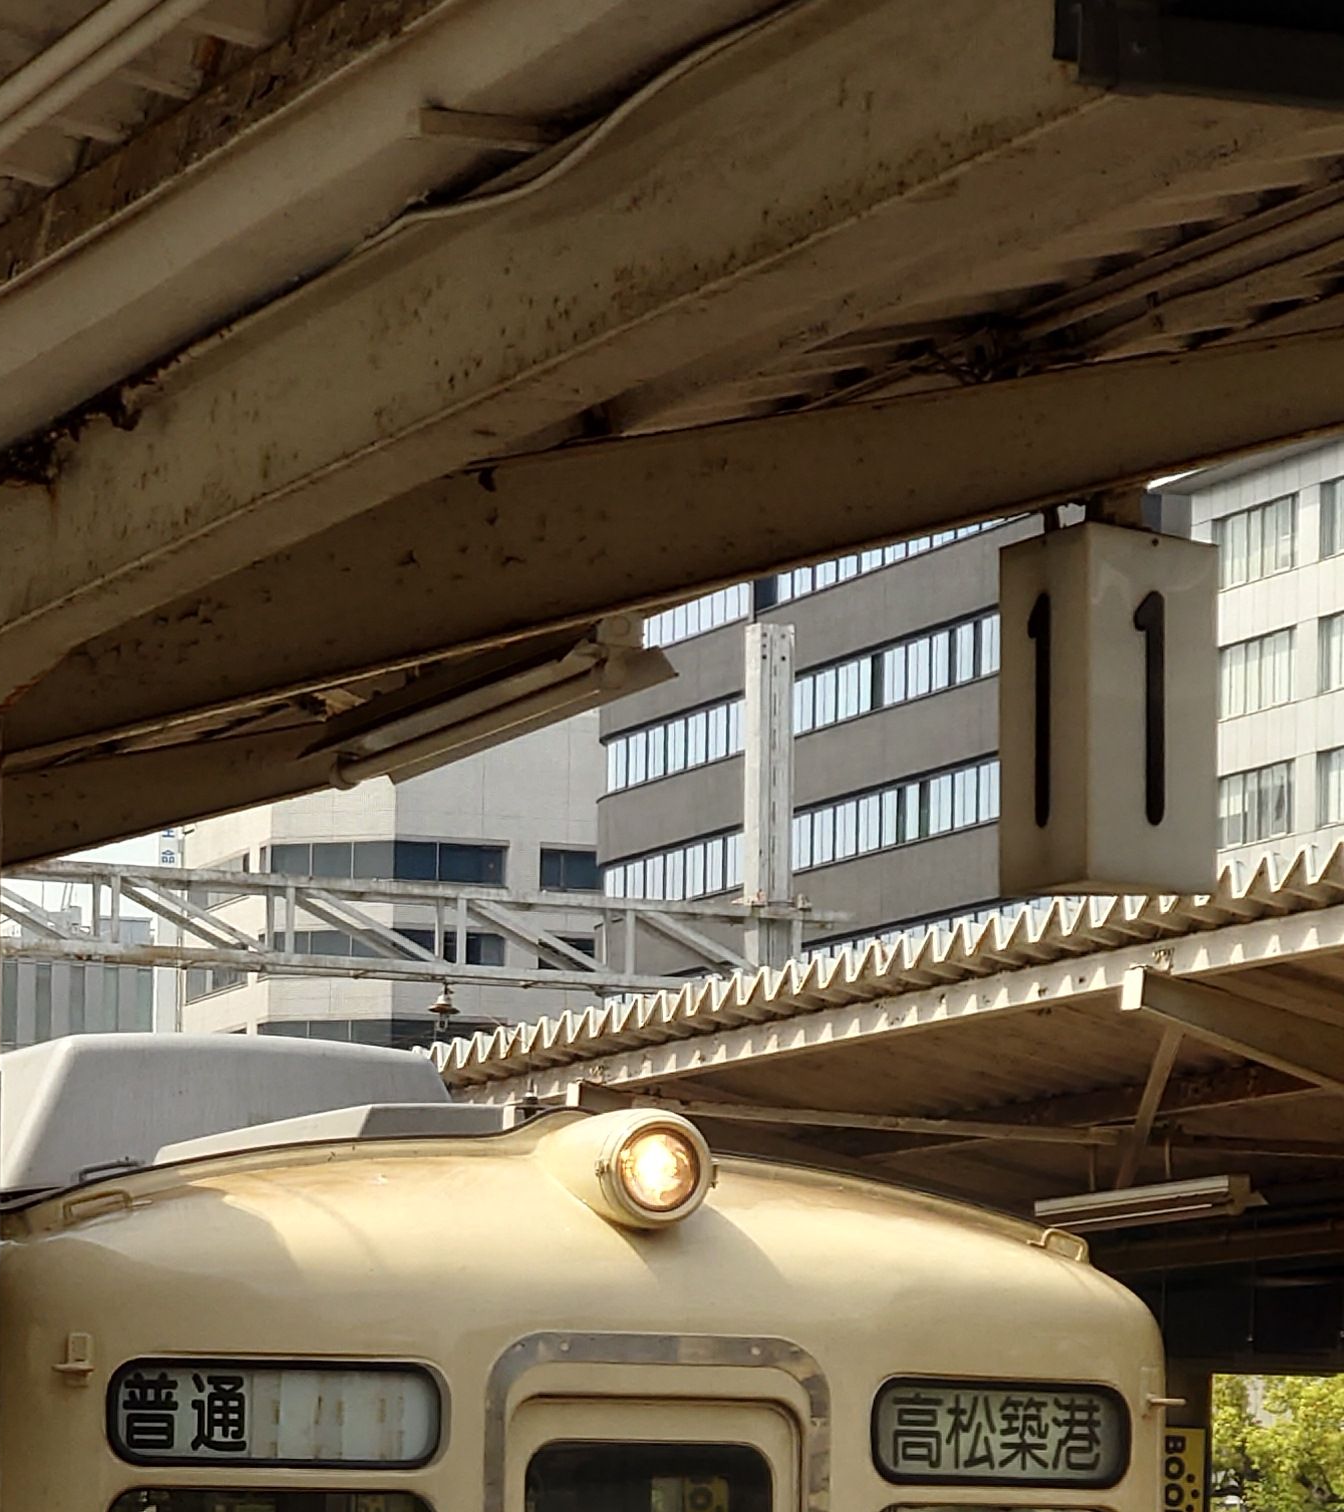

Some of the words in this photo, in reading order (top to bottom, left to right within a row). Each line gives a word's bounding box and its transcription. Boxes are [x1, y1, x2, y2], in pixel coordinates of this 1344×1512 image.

[1134, 591, 1165, 827] 1
[122, 1371, 248, 1452] 普通
[892, 1393, 1102, 1471] 高松築港
